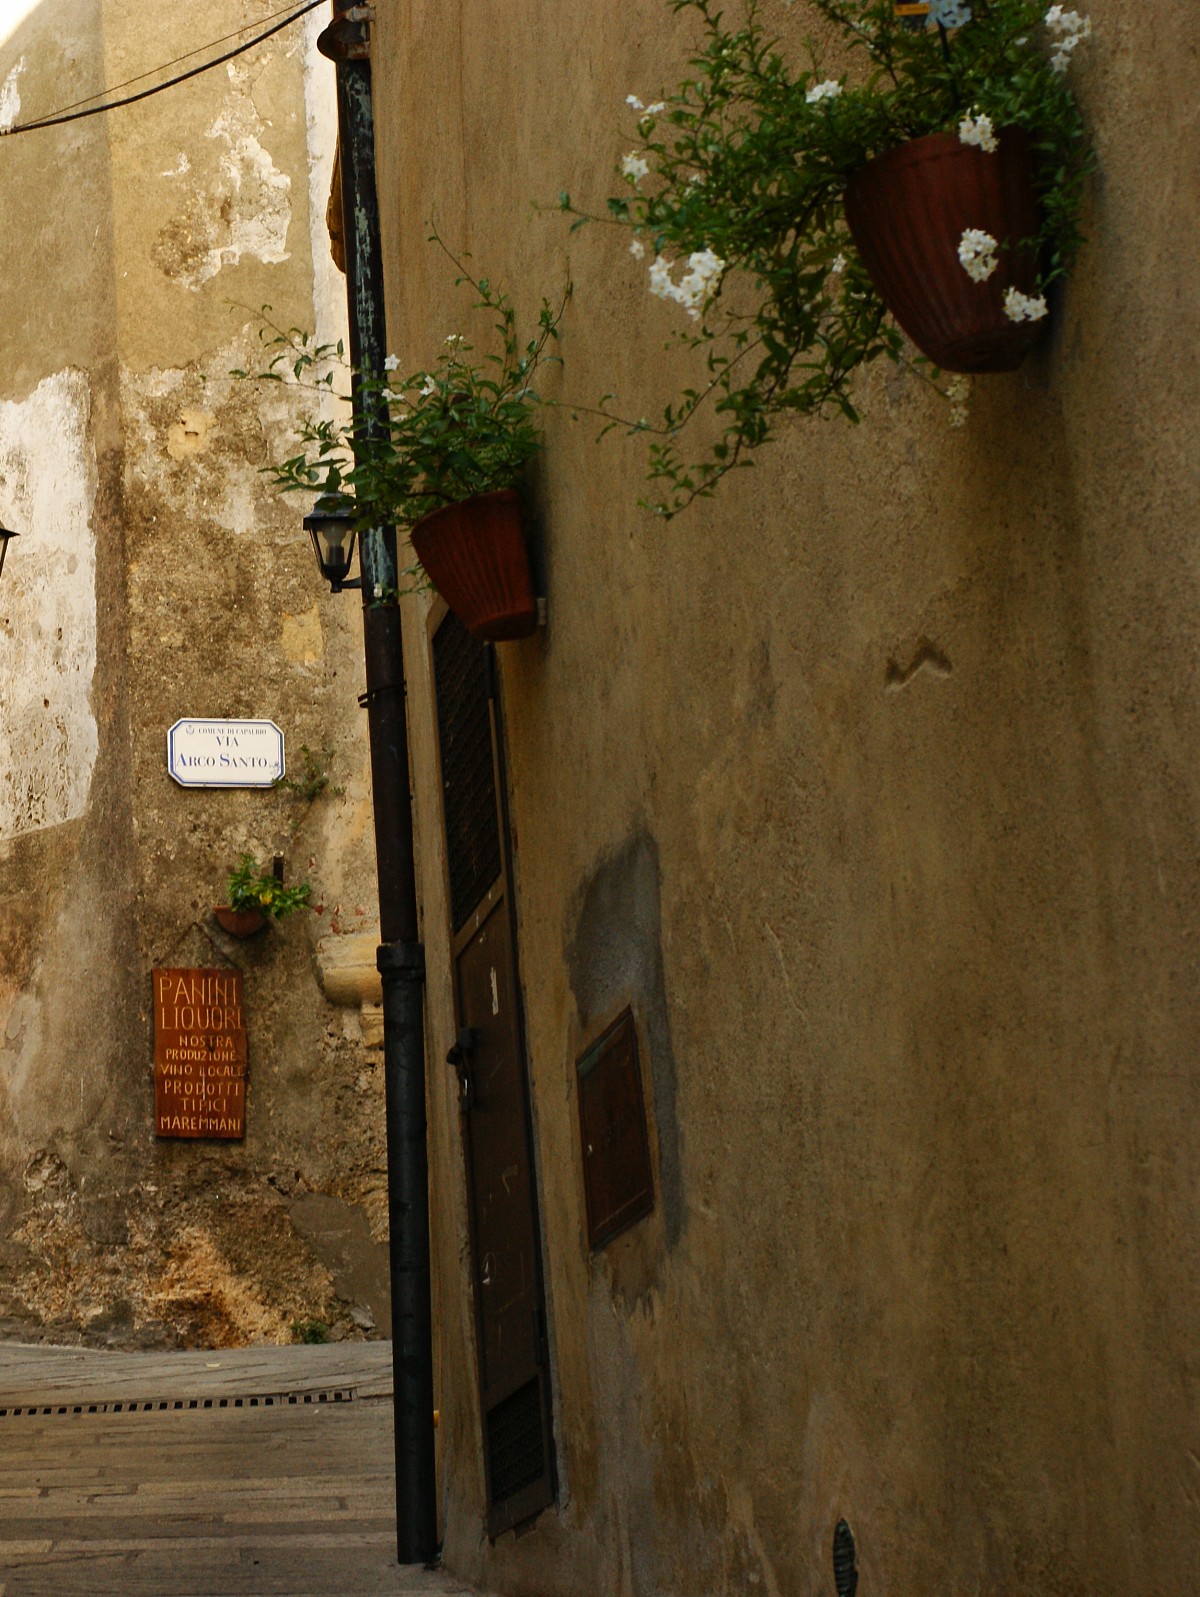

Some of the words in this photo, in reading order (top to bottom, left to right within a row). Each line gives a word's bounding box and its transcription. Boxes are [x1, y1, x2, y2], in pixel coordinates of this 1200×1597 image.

[216, 736, 239, 747] VIA
[160, 976, 237, 1006] PANINI
[161, 1006, 241, 1030] LIQUORI
[179, 1035, 233, 1048] NOSTRA
[165, 1048, 236, 1061] PRODUZIONE
[160, 1063, 193, 1076] VINO
[199, 1065, 244, 1077] LOCALE
[164, 1079, 239, 1097] PRODOTTI
[181, 1097, 226, 1112] TIPICI
[160, 1116, 241, 1131] MAREMMANI
